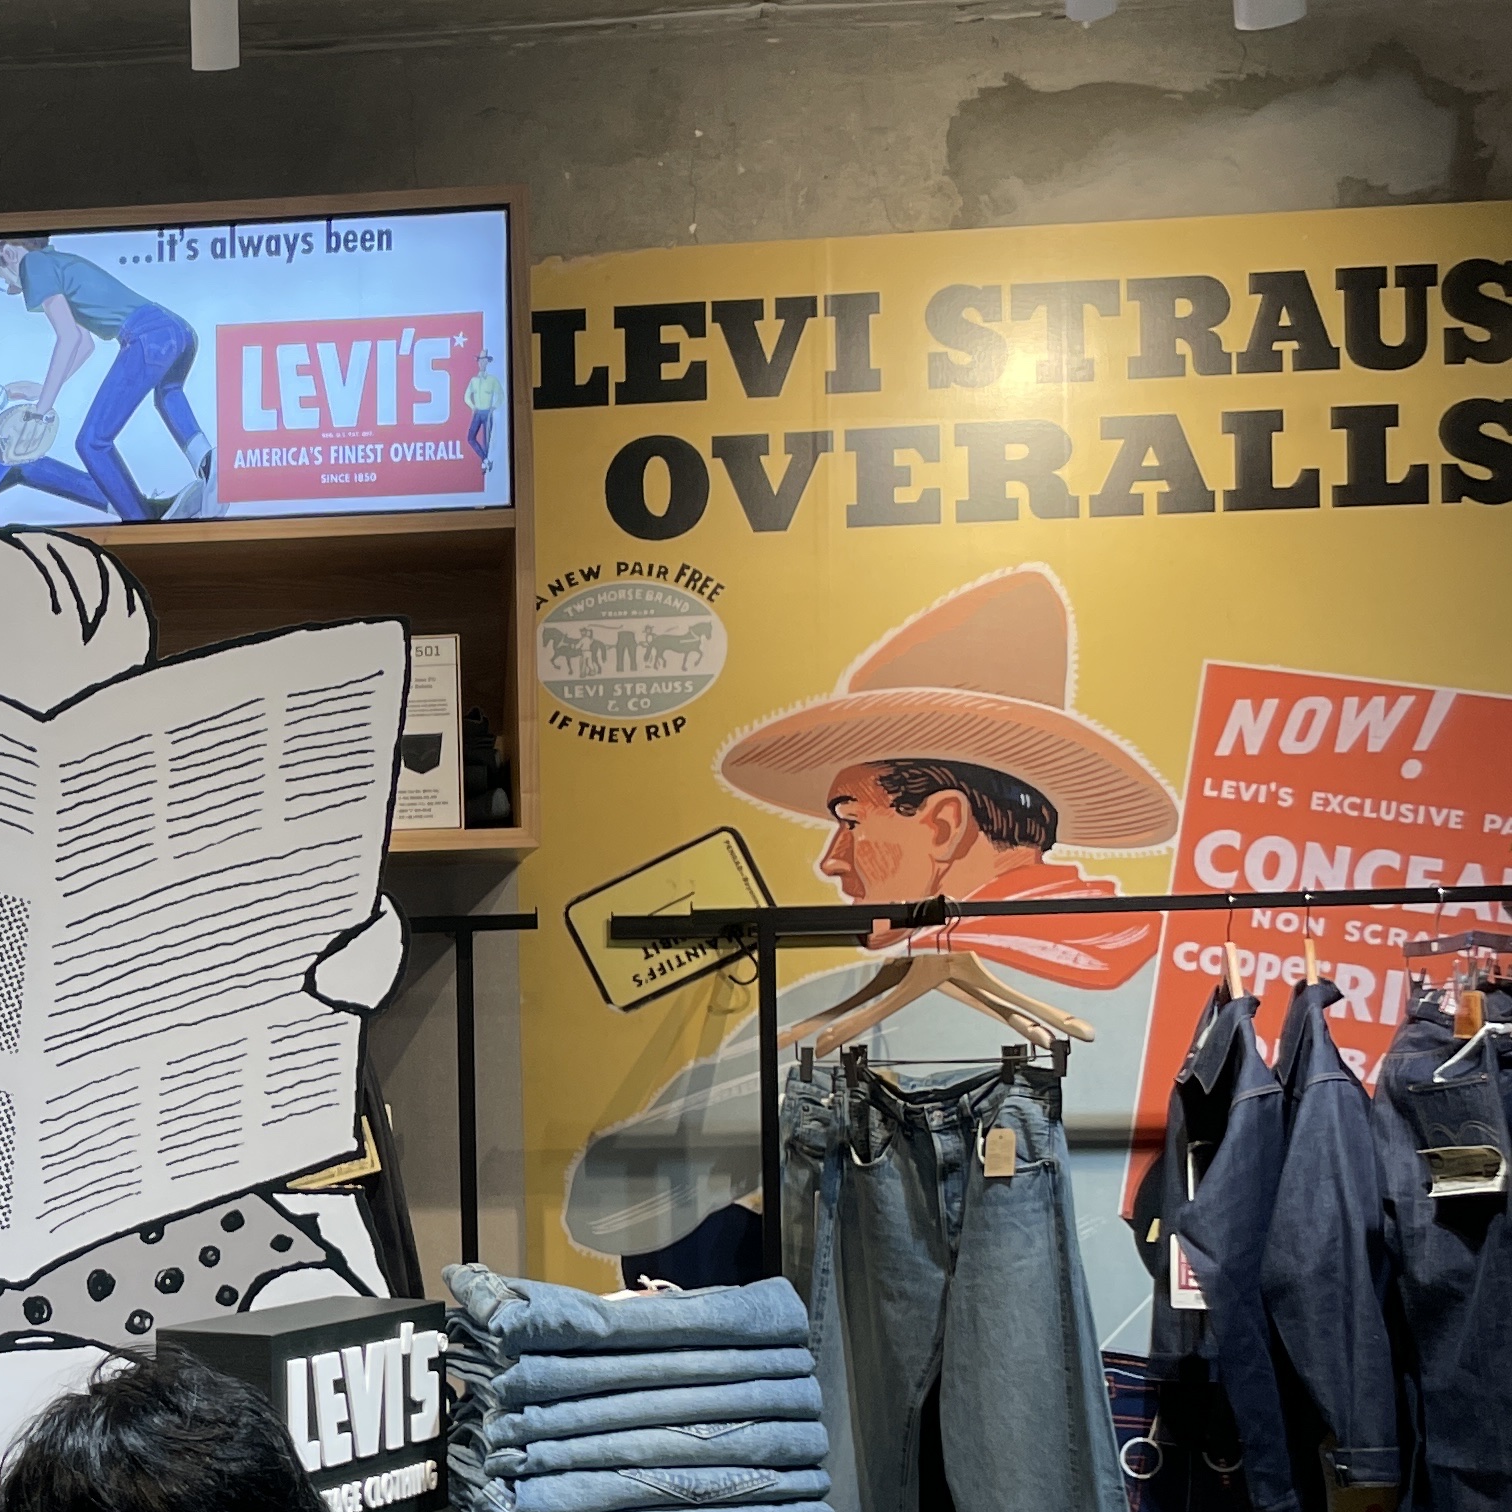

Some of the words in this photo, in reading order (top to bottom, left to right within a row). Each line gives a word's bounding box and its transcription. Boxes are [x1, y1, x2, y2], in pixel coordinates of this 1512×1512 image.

[211, 223, 314, 263] always
[326, 218, 393, 254] been
[531, 291, 881, 410] LEVI
[241, 327, 455, 433] LEVI'S
[234, 445, 323, 469] AMERICA'S
[330, 443, 384, 465] FINEST
[390, 440, 464, 463] OVERALL
[605, 397, 1512, 542] OVERALLS
[321, 473, 350, 484] SINCE
[547, 564, 602, 598] NEW
[616, 561, 670, 582] PAIR
[674, 562, 725, 603] FREE
[563, 595, 595, 617] TWO
[597, 588, 643, 605] HORSE
[645, 590, 690, 614] BRAND
[415, 645, 440, 657] 501
[563, 684, 604, 699] LEVI
[613, 680, 694, 697] STRAUSS
[627, 698, 651, 711] CO
[548, 711, 573, 730] IF
[577, 721, 637, 744] THEY
[645, 715, 687, 742] RIP
[1214, 690, 1458, 780] NOW!
[1202, 777, 1295, 807] LEVI'S
[1310, 791, 1465, 831] EXCLUSIVE
[1193, 829, 1512, 924] CONCEA
[1251, 909, 1326, 938] NON
[286, 1321, 440, 1473] LEVI'S
[364, 1460, 438, 1508] CLOTHING
